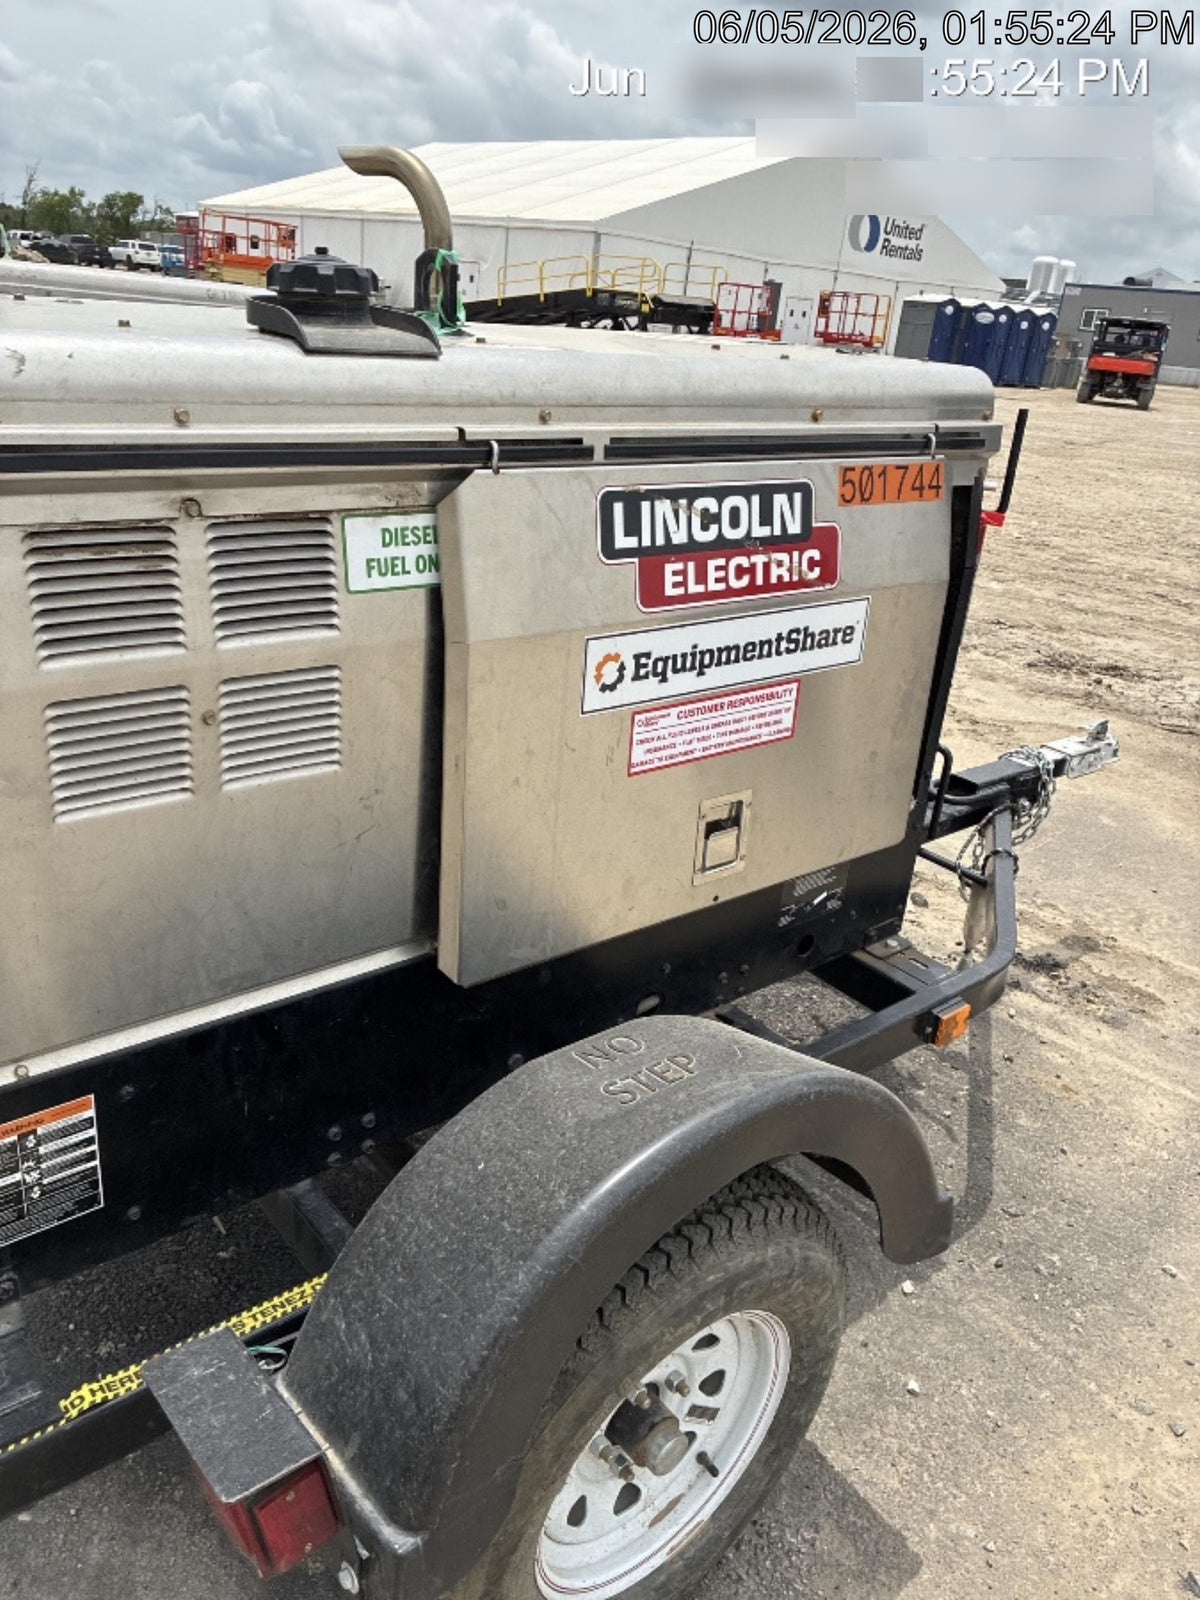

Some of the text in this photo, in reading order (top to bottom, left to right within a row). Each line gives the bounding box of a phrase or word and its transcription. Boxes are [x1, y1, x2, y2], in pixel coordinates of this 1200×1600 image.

[883, 216, 925, 241] United
[880, 237, 923, 262] Rentals
[840, 463, 943, 503] 501744
[612, 491, 803, 550] LINCOLN
[365, 555, 411, 579] FUEL
[664, 548, 821, 597] ELECTRIC
[631, 624, 856, 684] EquipmentShare
[676, 700, 726, 721] CUSTOMER
[726, 687, 794, 710] RESPONSIBILITY
[572, 1036, 645, 1070] NO
[601, 1053, 697, 1105] STEP
